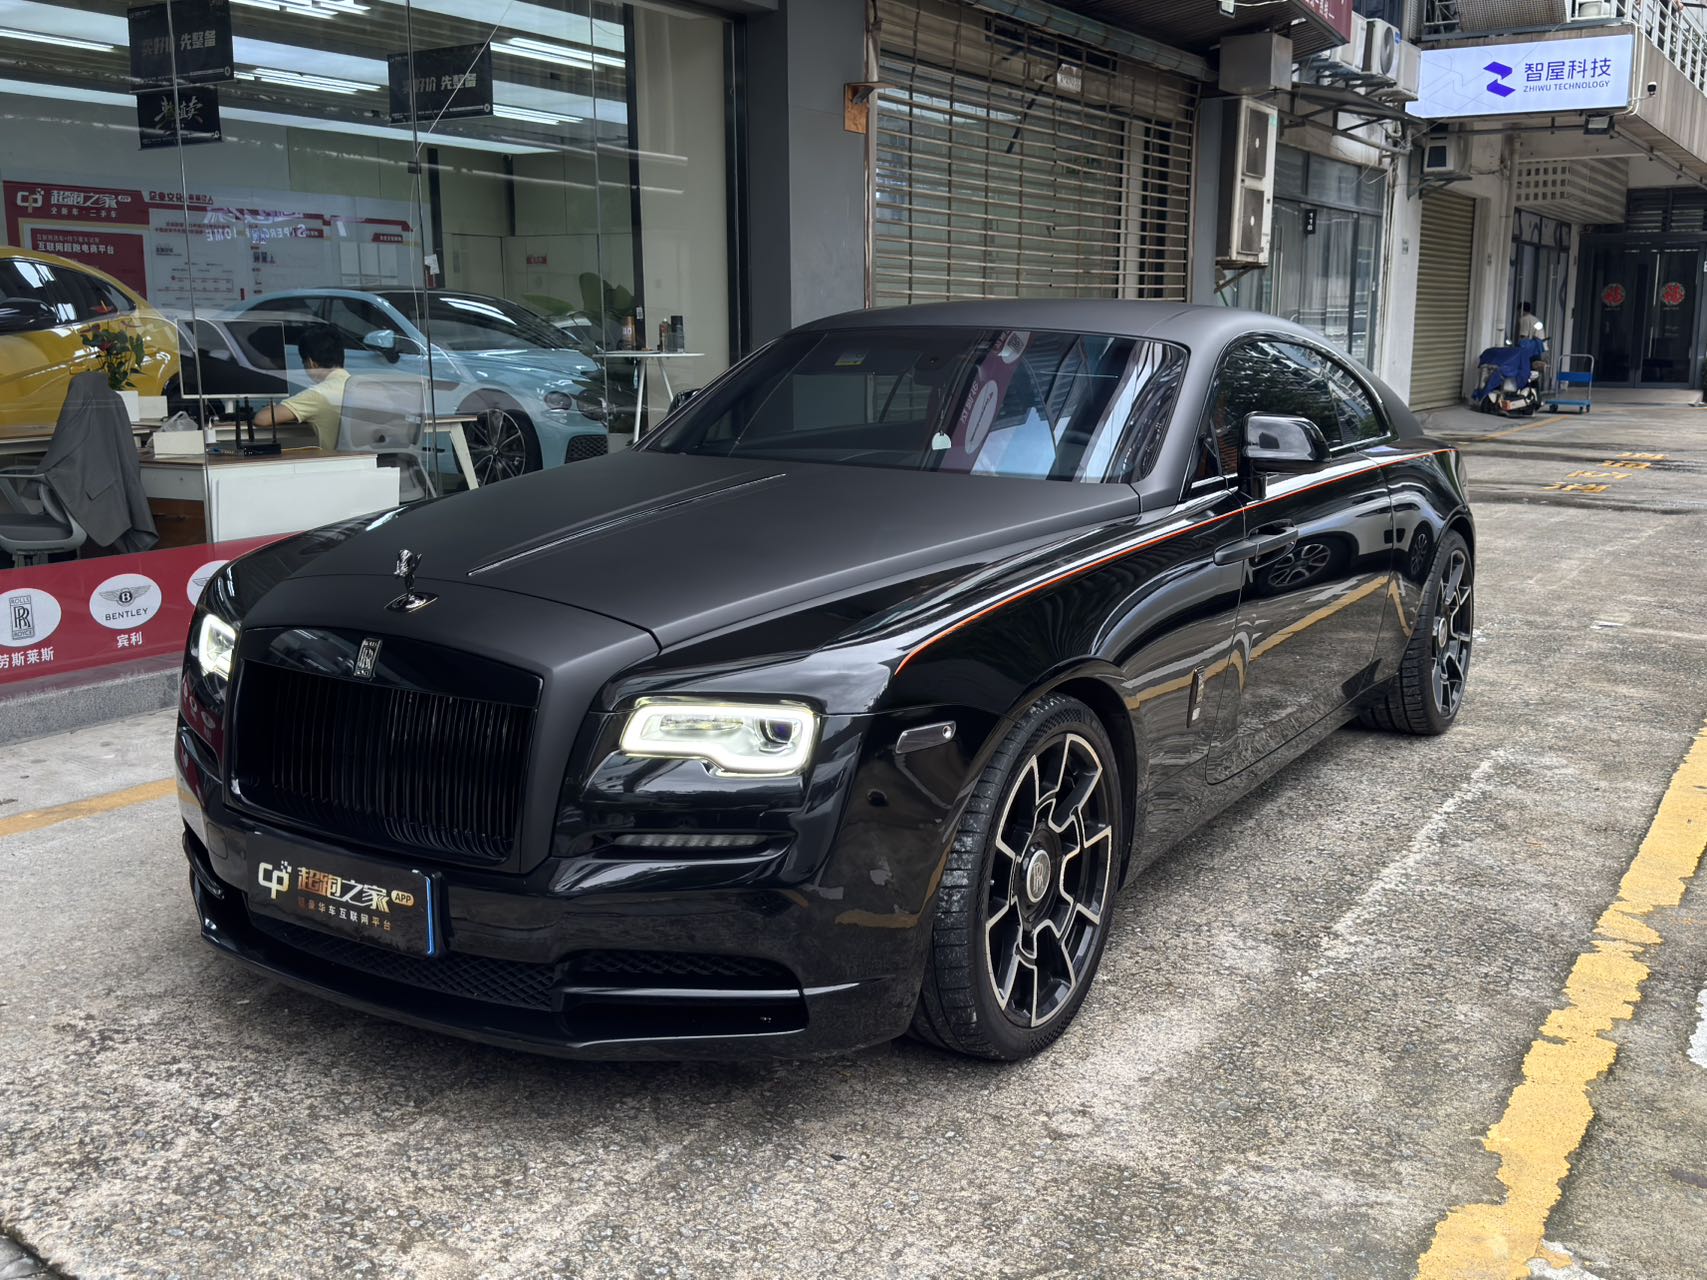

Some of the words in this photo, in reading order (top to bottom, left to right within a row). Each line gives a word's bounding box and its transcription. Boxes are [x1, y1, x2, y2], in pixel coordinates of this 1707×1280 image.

[1524, 58, 1612, 82] 智屋科技
[1523, 84, 1552, 93] ZHIWU
[1554, 80, 1611, 91] TECHNOLOGY
[105, 608, 149, 621] BENTLEY
[116, 632, 143, 649] 宾利
[297, 867, 390, 913] 超跑之家
[393, 890, 413, 905] APP
